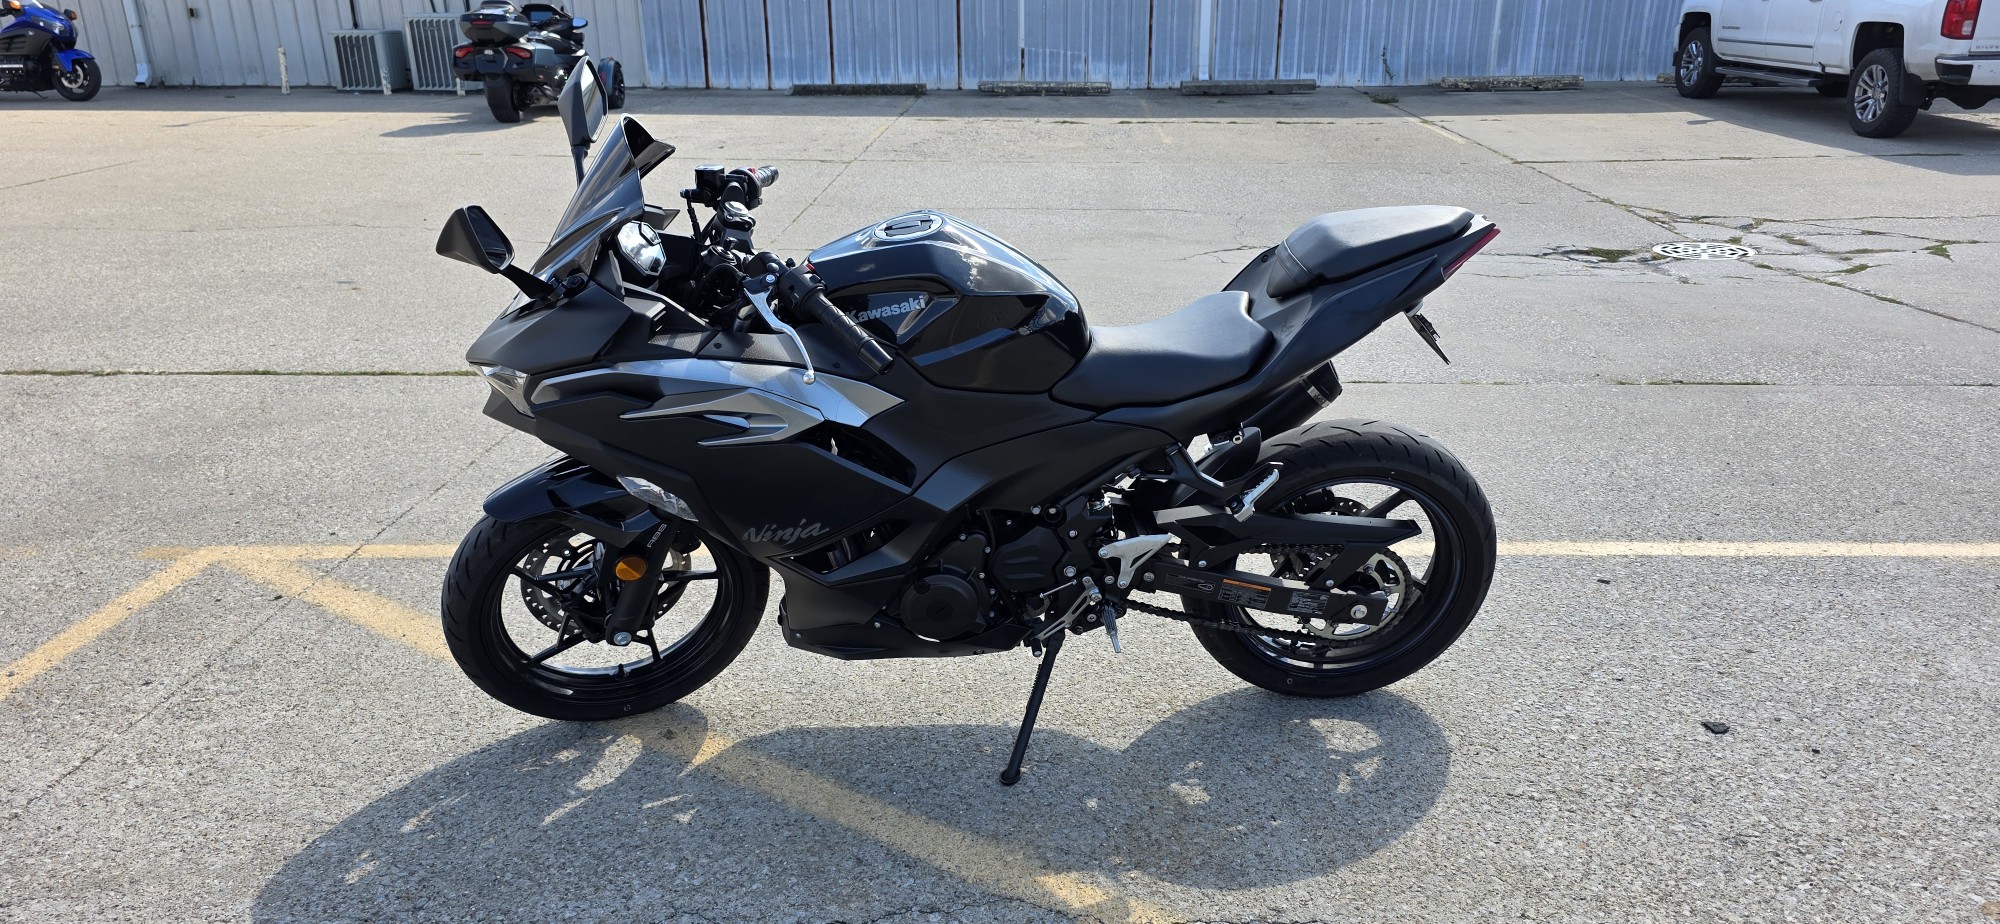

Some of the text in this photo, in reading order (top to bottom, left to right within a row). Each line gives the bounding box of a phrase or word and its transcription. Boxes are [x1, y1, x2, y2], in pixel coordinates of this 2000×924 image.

[845, 295, 926, 324] Kawasaki
[647, 523, 667, 548] ABS
[741, 518, 830, 547] Ninja
